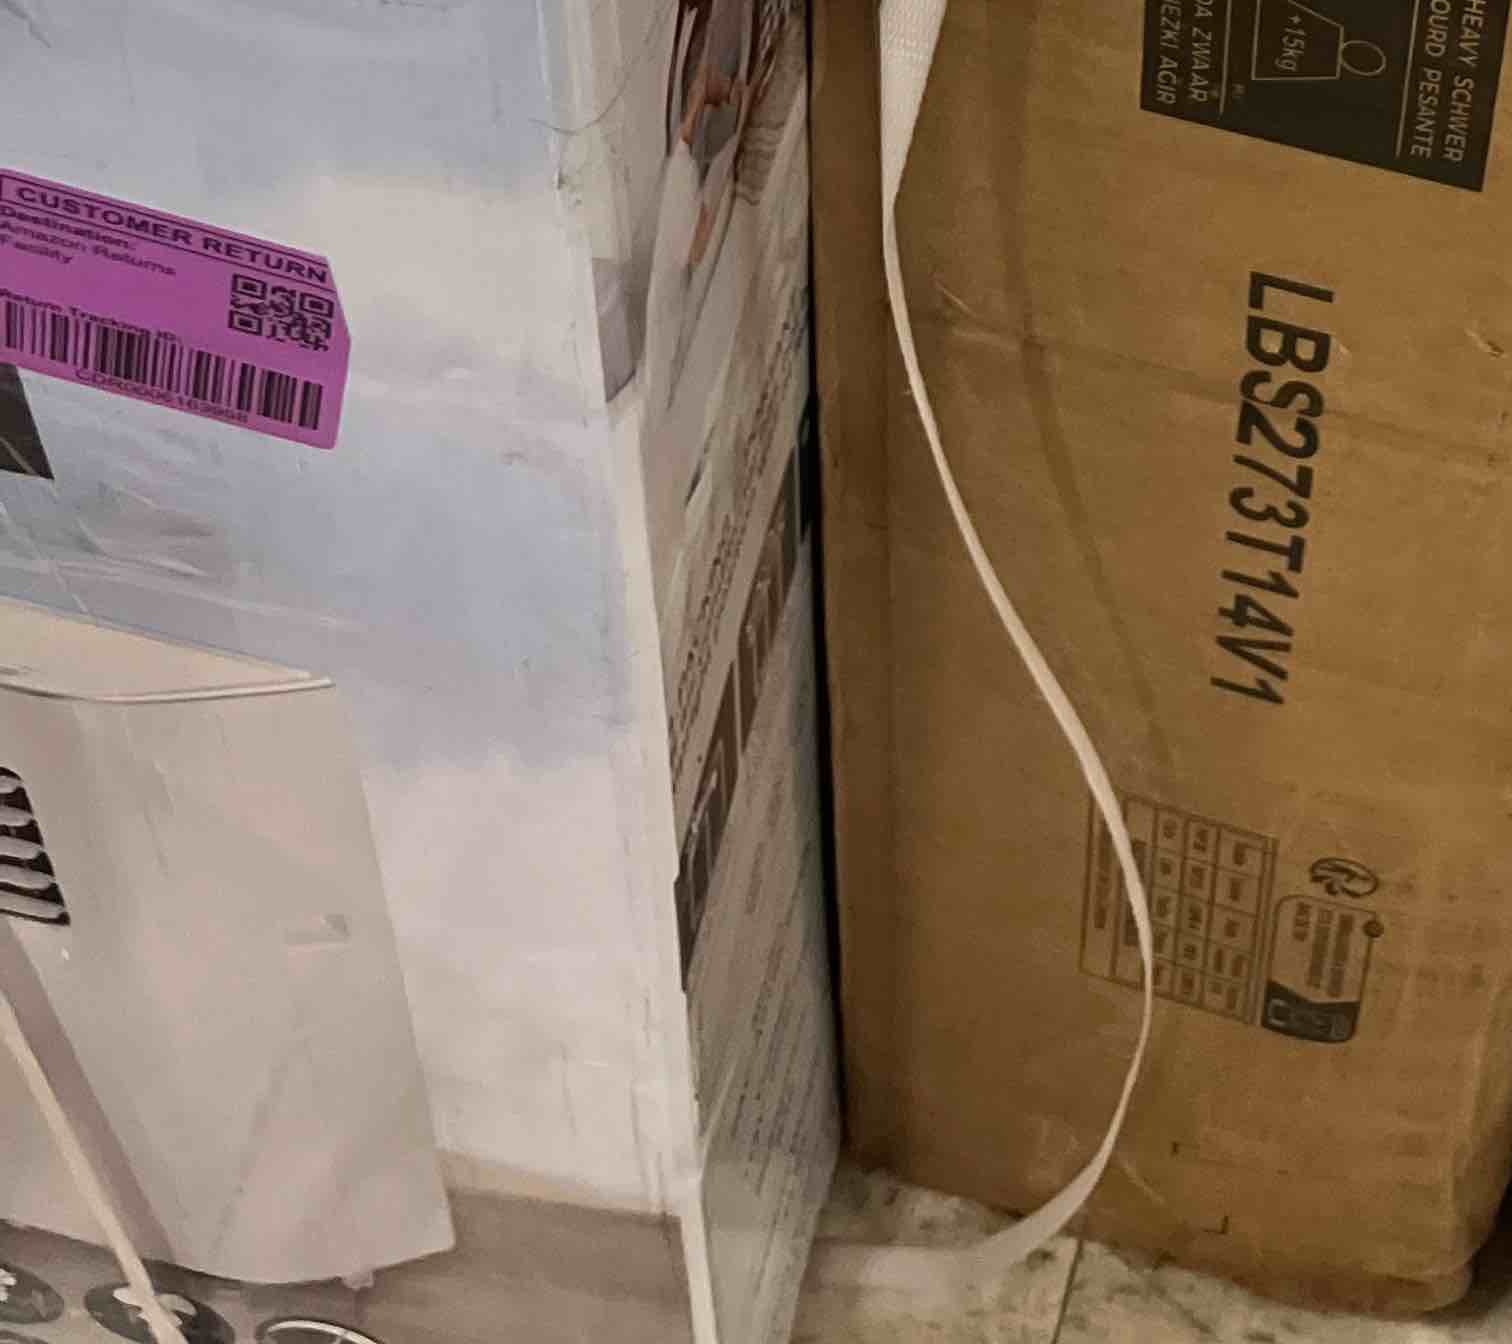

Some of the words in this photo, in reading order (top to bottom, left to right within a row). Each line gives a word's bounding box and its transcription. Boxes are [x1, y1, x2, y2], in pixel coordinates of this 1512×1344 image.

[1186, 26, 1216, 104] ZWAAR
[1273, 14, 1307, 74] +15kg
[1409, 67, 1442, 160] PESANTE
[1441, 76, 1476, 164] SCHWER
[16, 186, 193, 246] CUSTOMER
[202, 236, 328, 284] RETURN
[1210, 269, 1336, 705] LBS273T14V1
